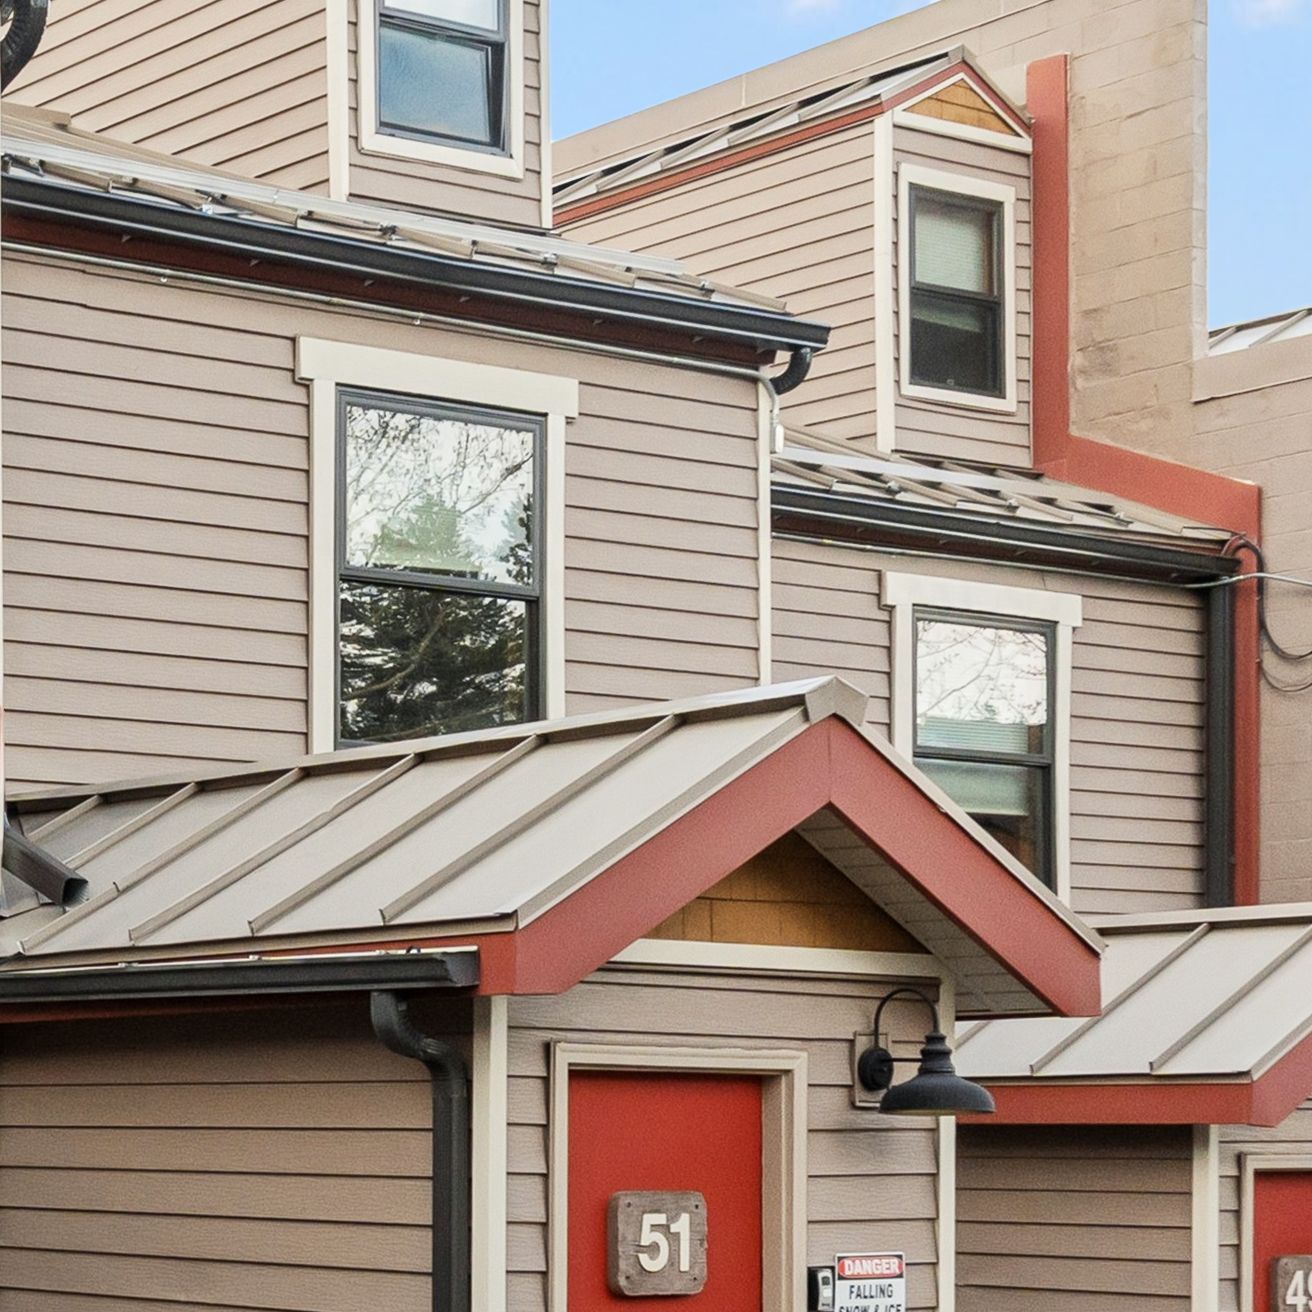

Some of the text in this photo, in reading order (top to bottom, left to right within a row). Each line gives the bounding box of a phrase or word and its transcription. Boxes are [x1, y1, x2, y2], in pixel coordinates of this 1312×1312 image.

[637, 1212, 691, 1272] 51
[844, 1258, 900, 1276] DANGER
[848, 1283, 894, 1300] FALLING
